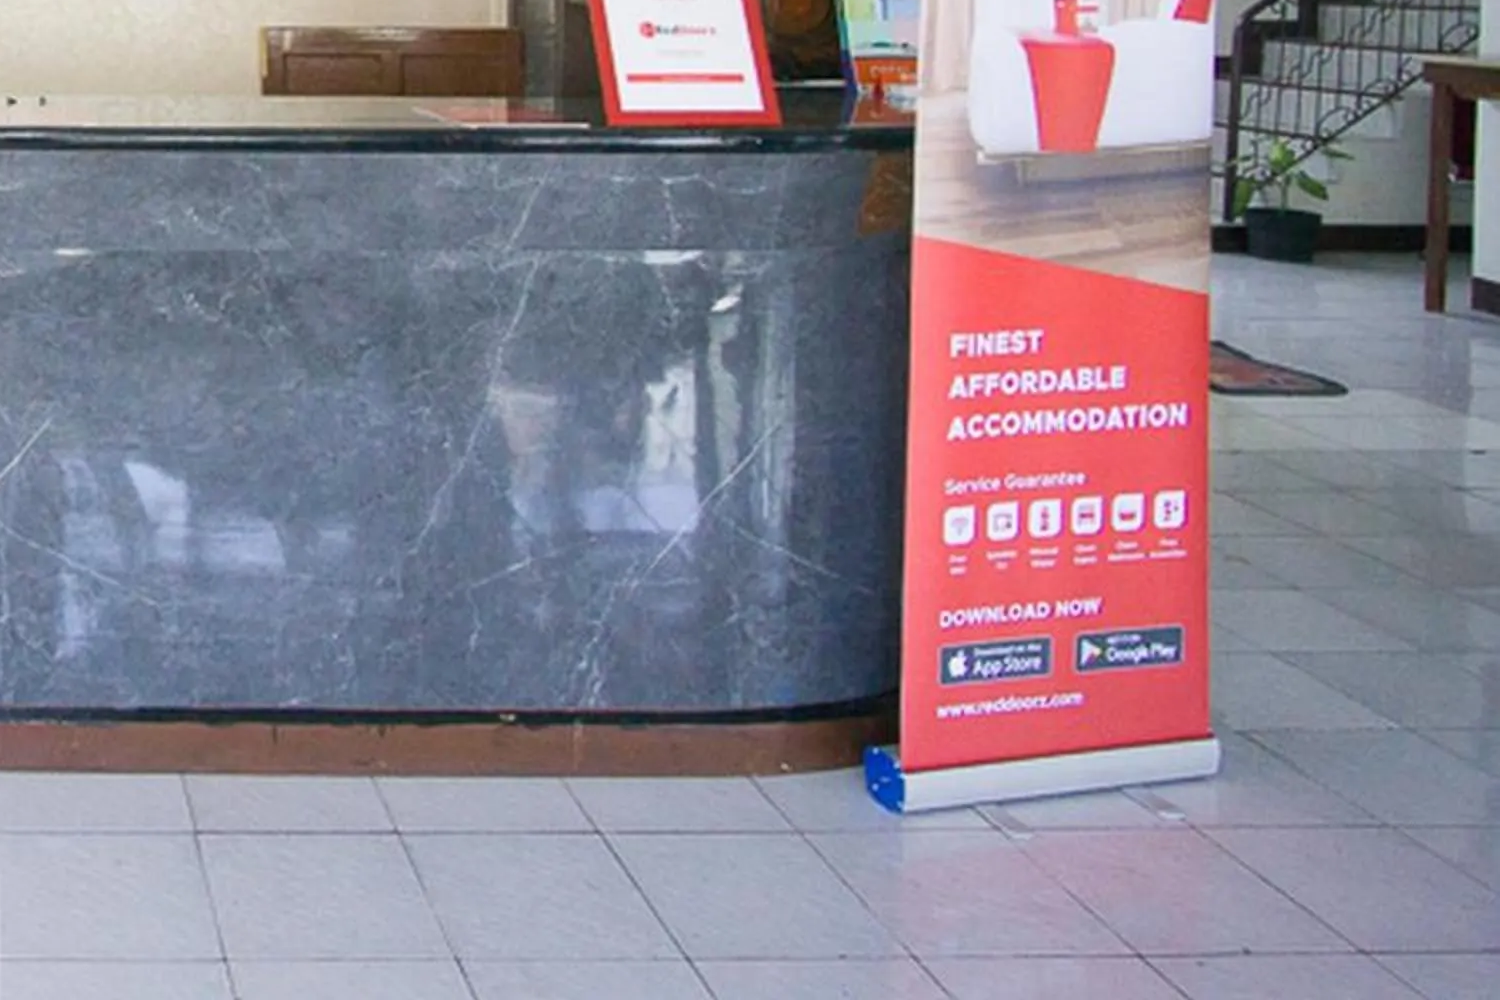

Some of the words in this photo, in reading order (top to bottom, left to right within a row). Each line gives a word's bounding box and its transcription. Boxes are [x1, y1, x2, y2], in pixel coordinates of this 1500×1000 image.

[950, 329, 1043, 357] FINEST
[949, 366, 1126, 399] AFFORDABLE
[947, 403, 1188, 440] ACCOMMODATION
[945, 476, 1000, 494] Service
[1004, 471, 1086, 490] Guarantee
[939, 601, 1051, 628] DOWNLOAD
[1056, 597, 1102, 617] NOW
[972, 658, 1002, 679] App
[1003, 655, 1042, 674] Store
[1105, 646, 1148, 665] Google
[1148, 642, 1177, 660] Play
[936, 692, 1084, 718] www.reddoorz.com
